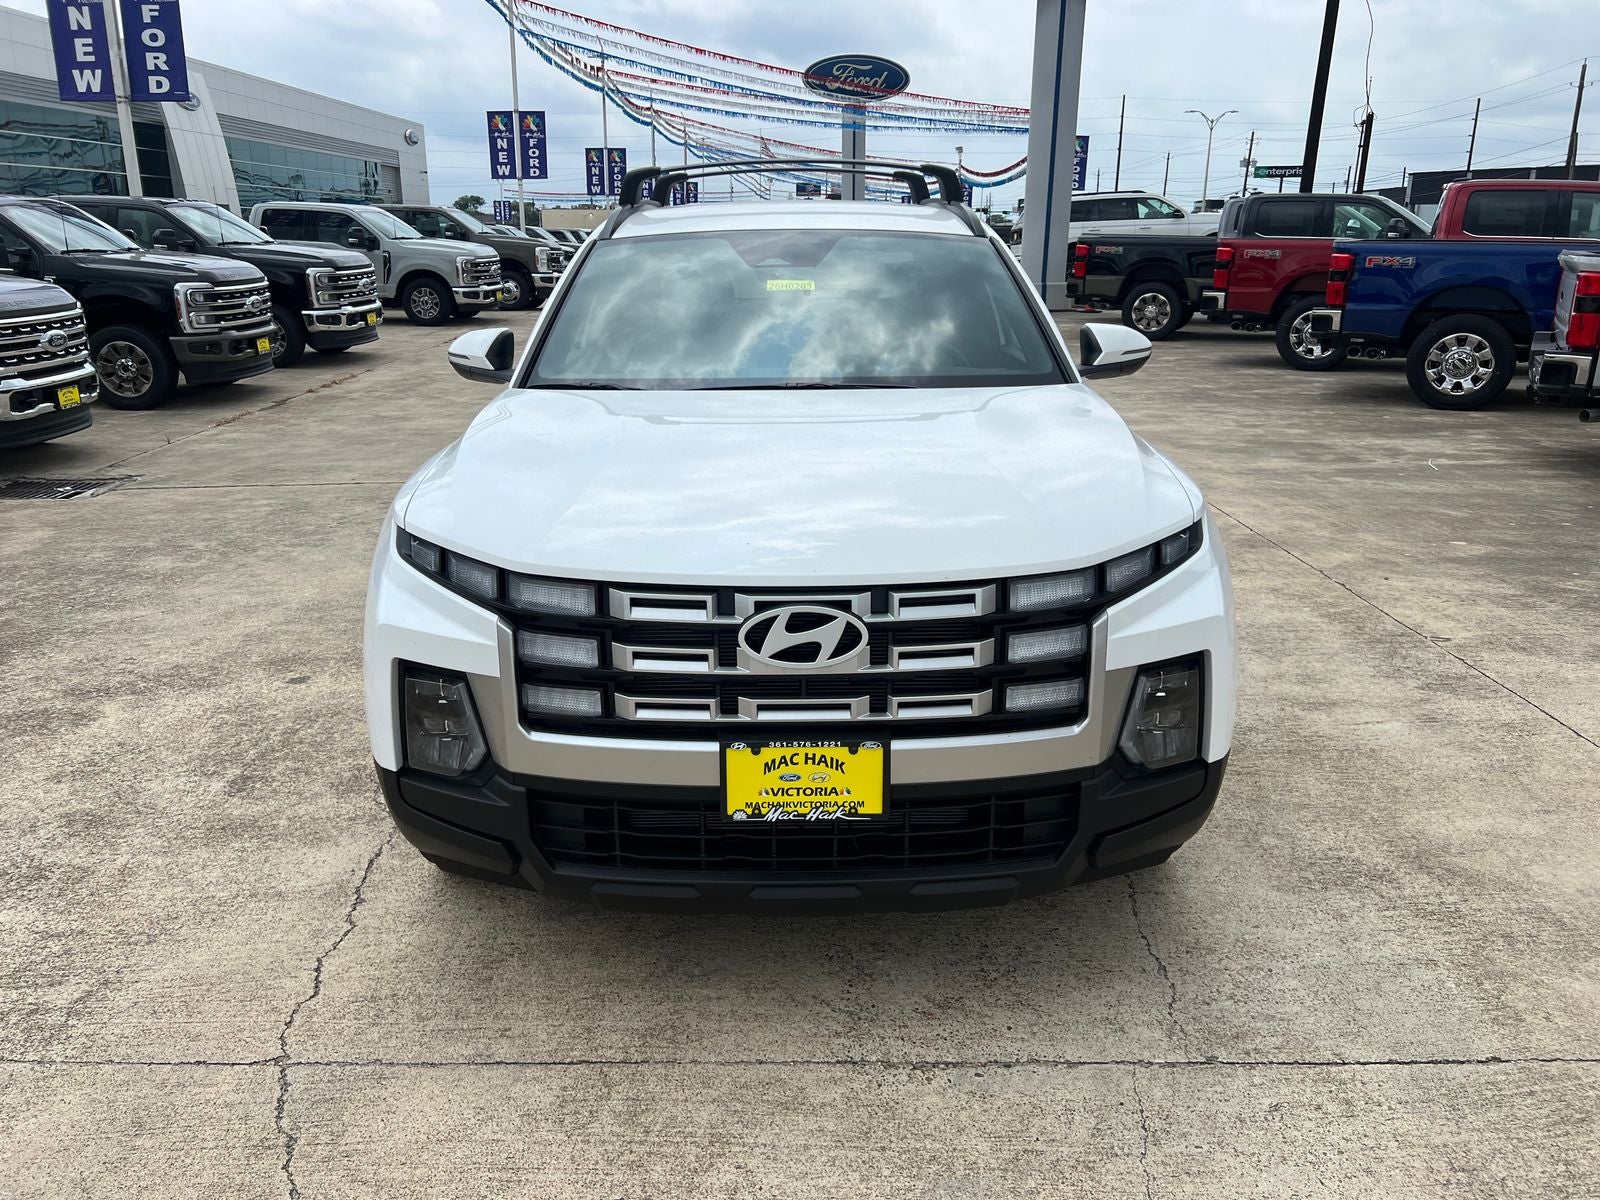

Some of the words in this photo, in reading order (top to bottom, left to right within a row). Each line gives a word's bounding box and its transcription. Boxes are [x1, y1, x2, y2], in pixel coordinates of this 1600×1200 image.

[67, 5, 102, 94] NEW
[140, 4, 170, 94] FORD
[496, 138, 511, 176] NEW
[528, 138, 540, 177] FORD
[591, 167, 601, 194] NEW
[614, 167, 622, 194] FORD
[1071, 157, 1081, 189] FORD
[1243, 249, 1281, 259] FX4
[1365, 256, 1416, 268] FX4
[763, 752, 800, 776] MAC
[804, 752, 846, 775] HAIK
[744, 800, 865, 809] MACHAIKVICTORIA.COM
[770, 787, 840, 797] VICTORIA
[763, 806, 804, 822] Mac
[805, 806, 850, 822] Haik
